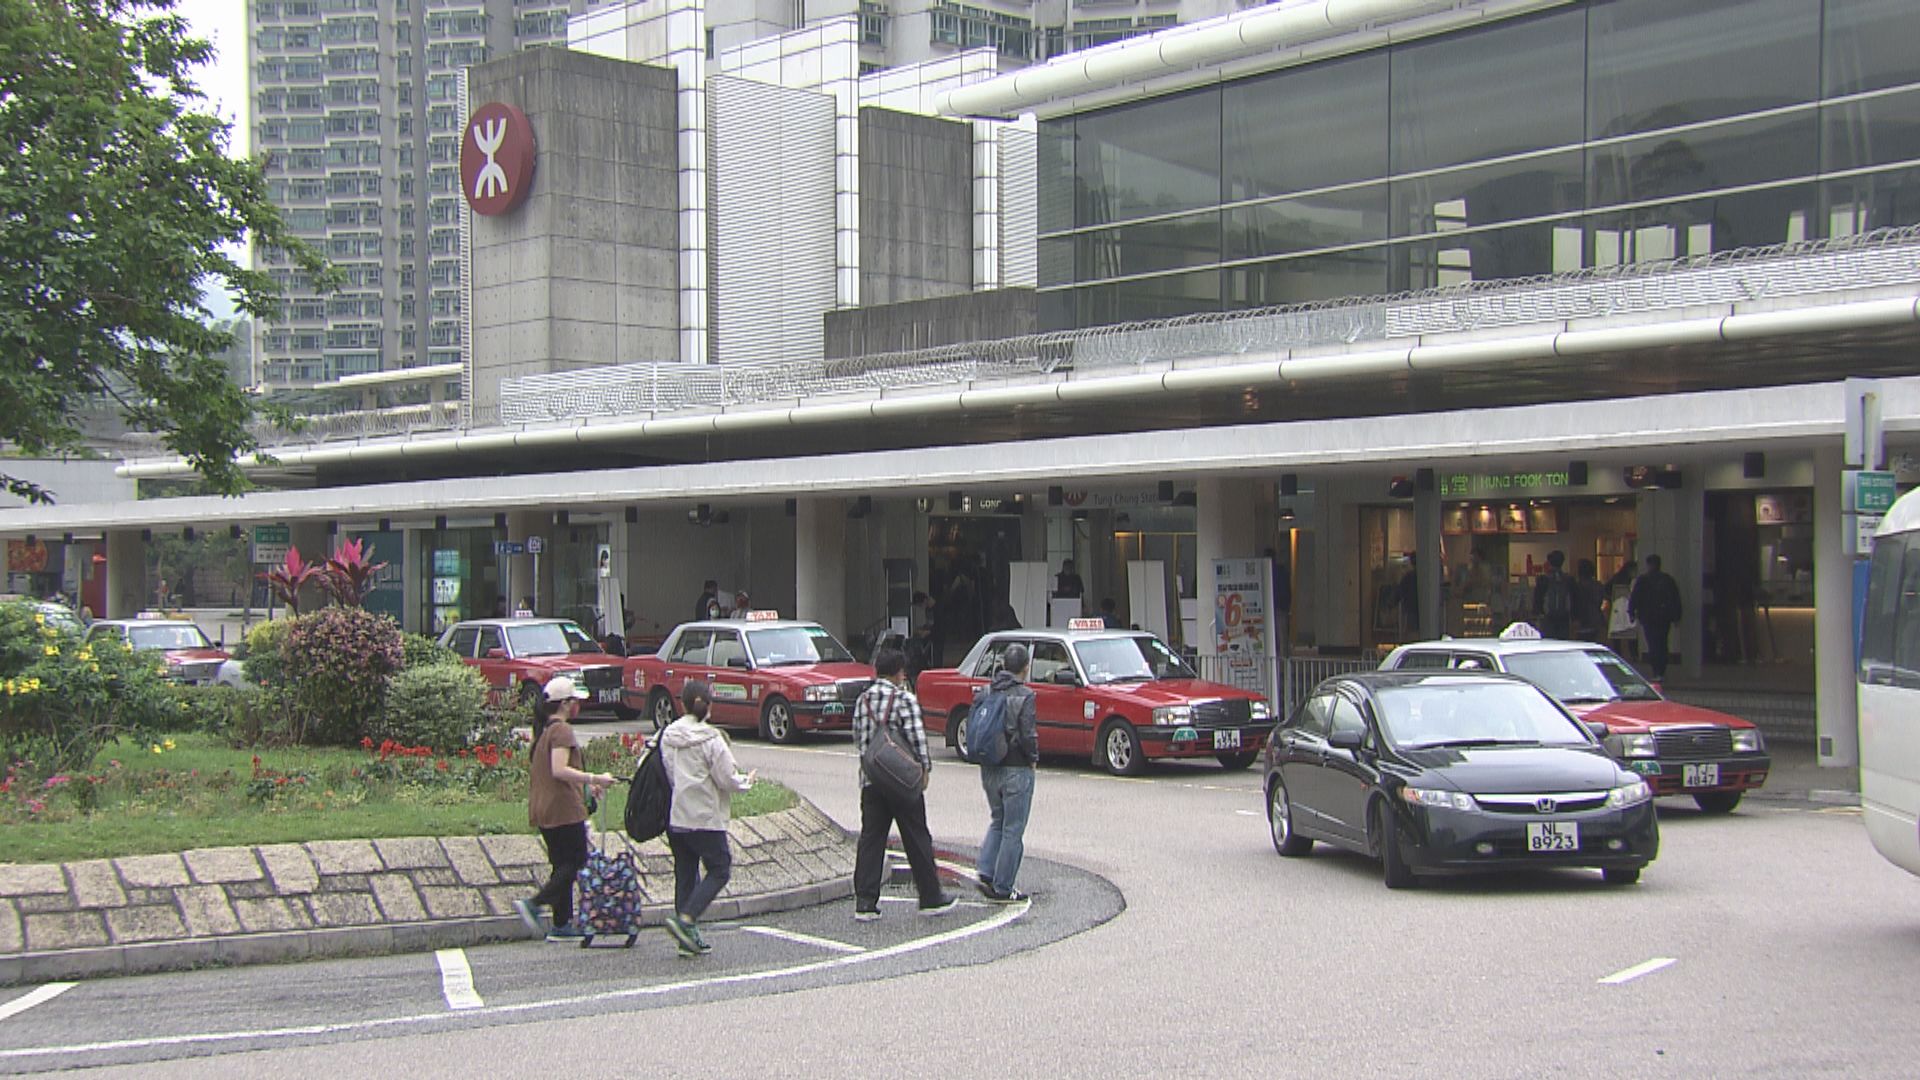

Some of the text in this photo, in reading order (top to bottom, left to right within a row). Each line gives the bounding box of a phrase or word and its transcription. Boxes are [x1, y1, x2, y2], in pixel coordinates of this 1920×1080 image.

[1480, 476, 1510, 489] HUNG
[1514, 473, 1542, 487] FOOK
[1094, 494, 1112, 506] Tung
[1114, 492, 1138, 505] Chung
[1510, 629, 1534, 637] TAXI
[1541, 822, 1563, 836] NL
[1532, 836, 1574, 849] 8923
